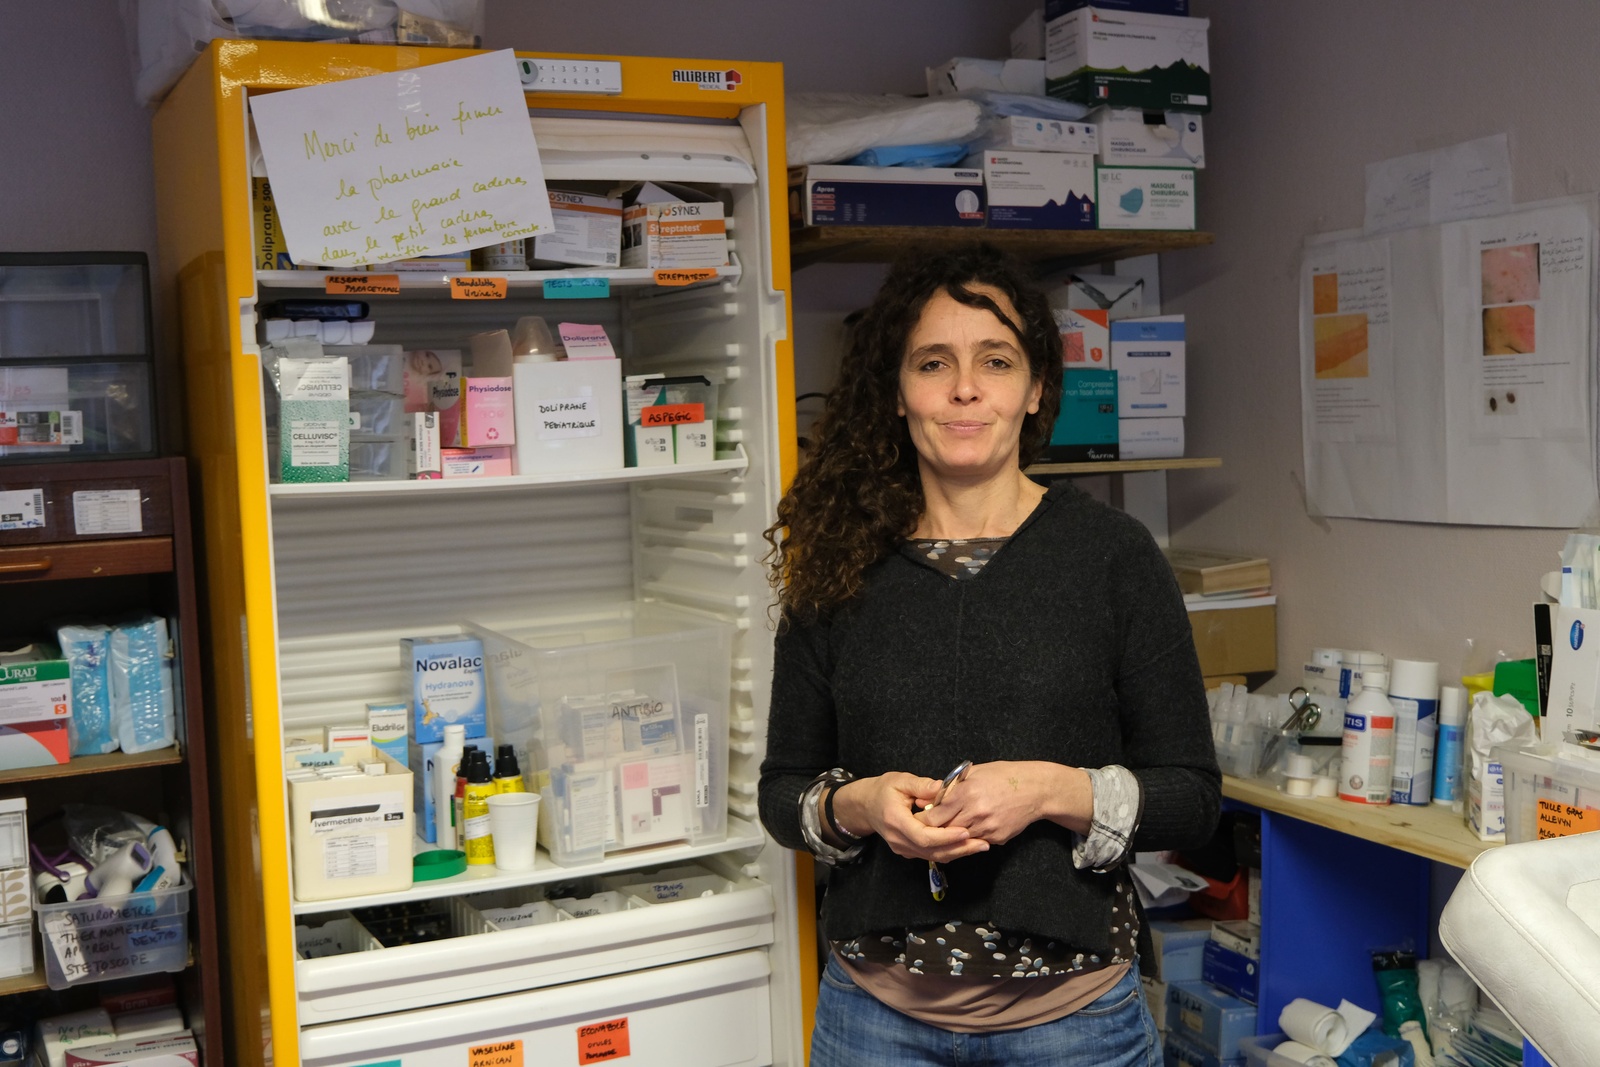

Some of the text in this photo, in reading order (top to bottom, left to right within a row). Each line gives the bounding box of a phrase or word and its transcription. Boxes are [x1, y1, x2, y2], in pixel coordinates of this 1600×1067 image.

[573, 77, 578, 85] 6
[304, 101, 503, 162] Merci de bien fermer
[336, 157, 463, 201] la pharmacie
[323, 176, 527, 237] avec le grand cadenas
[261, 183, 276, 270] Doliprane 500
[321, 209, 494, 263] dans le petit cadenas
[545, 280, 573, 288] TESTS
[658, 273, 710, 281] STREPTATEST
[468, 385, 512, 393] Physiodose
[1077, 380, 1115, 390] Compresses
[416, 656, 482, 672] Novalac
[425, 680, 474, 692] Hydranova
[57, 705, 65, 714] S
[1566, 708, 1573, 717] 10
[1539, 801, 1584, 819] TULLE GRAS
[314, 817, 363, 828] Ivermectine
[1540, 813, 1572, 828] ALLEVYN
[63, 905, 154, 926] SATUROMETRE
[60, 919, 160, 944] THERMOMETRE
[65, 953, 149, 976] STETOSCOPE
[472, 1042, 516, 1056] VASELINE
